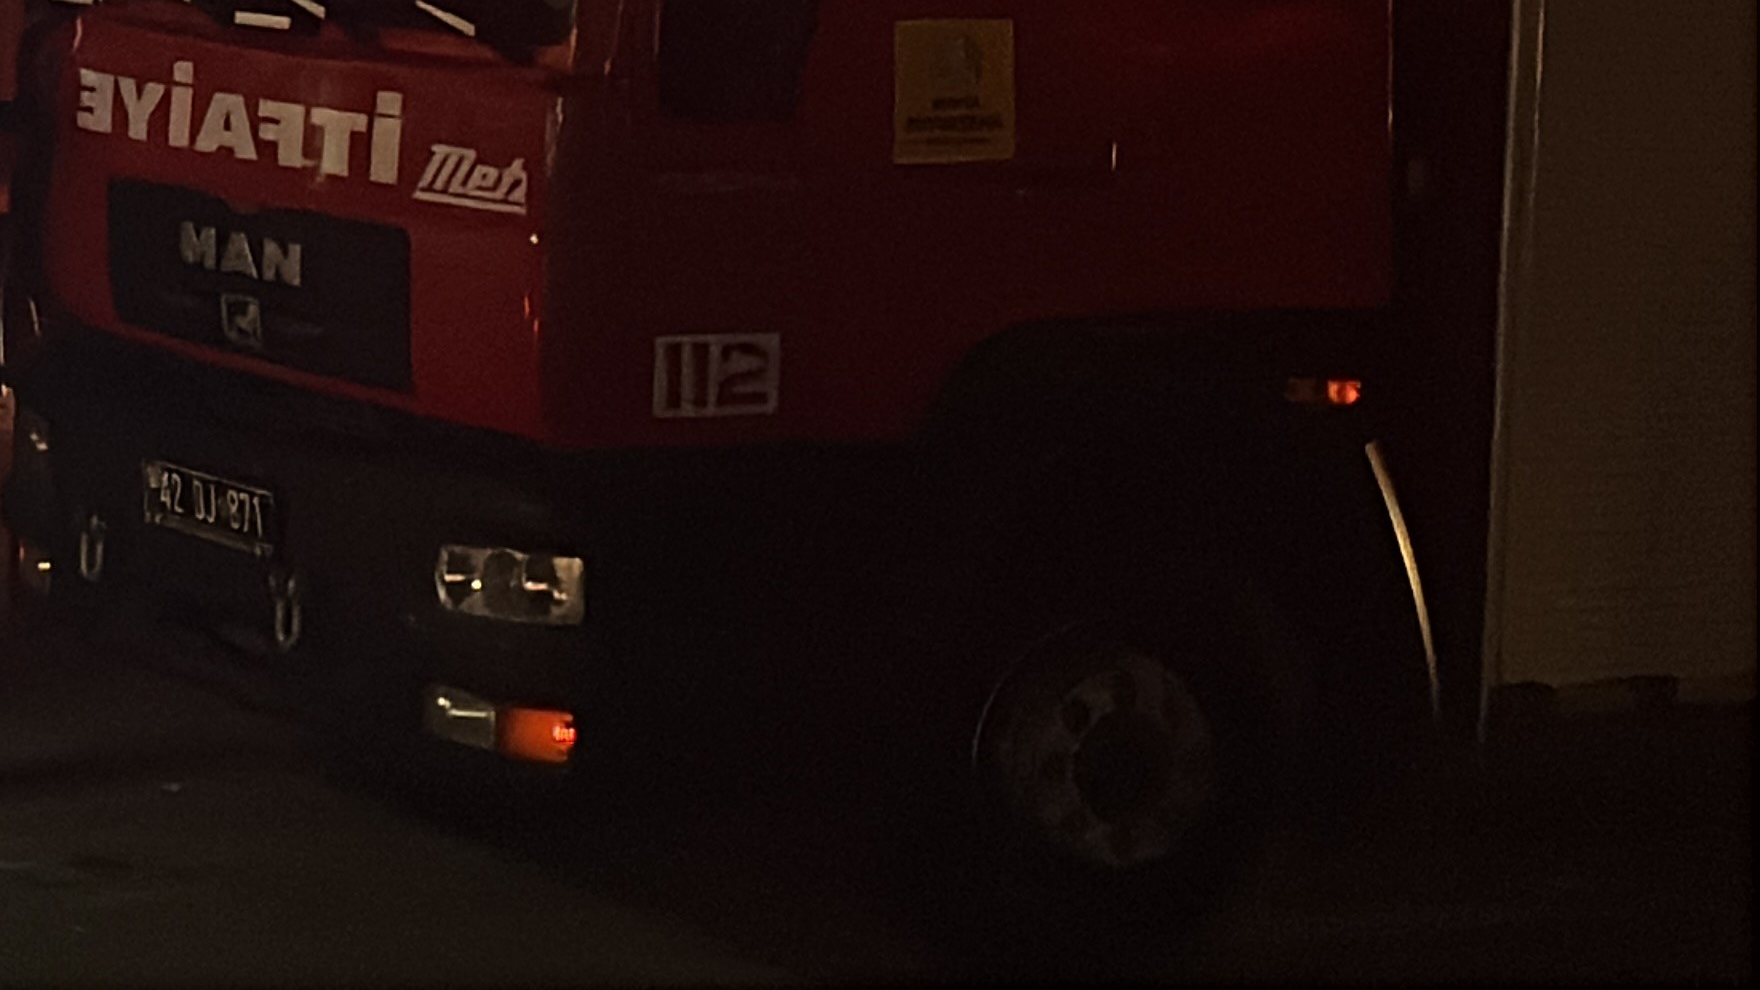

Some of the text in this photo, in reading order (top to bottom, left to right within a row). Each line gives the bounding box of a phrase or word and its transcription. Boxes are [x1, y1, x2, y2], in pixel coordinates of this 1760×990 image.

[179, 219, 303, 288] MAN
[663, 342, 770, 410] 112
[159, 470, 185, 515] 42
[226, 488, 264, 539] 871
